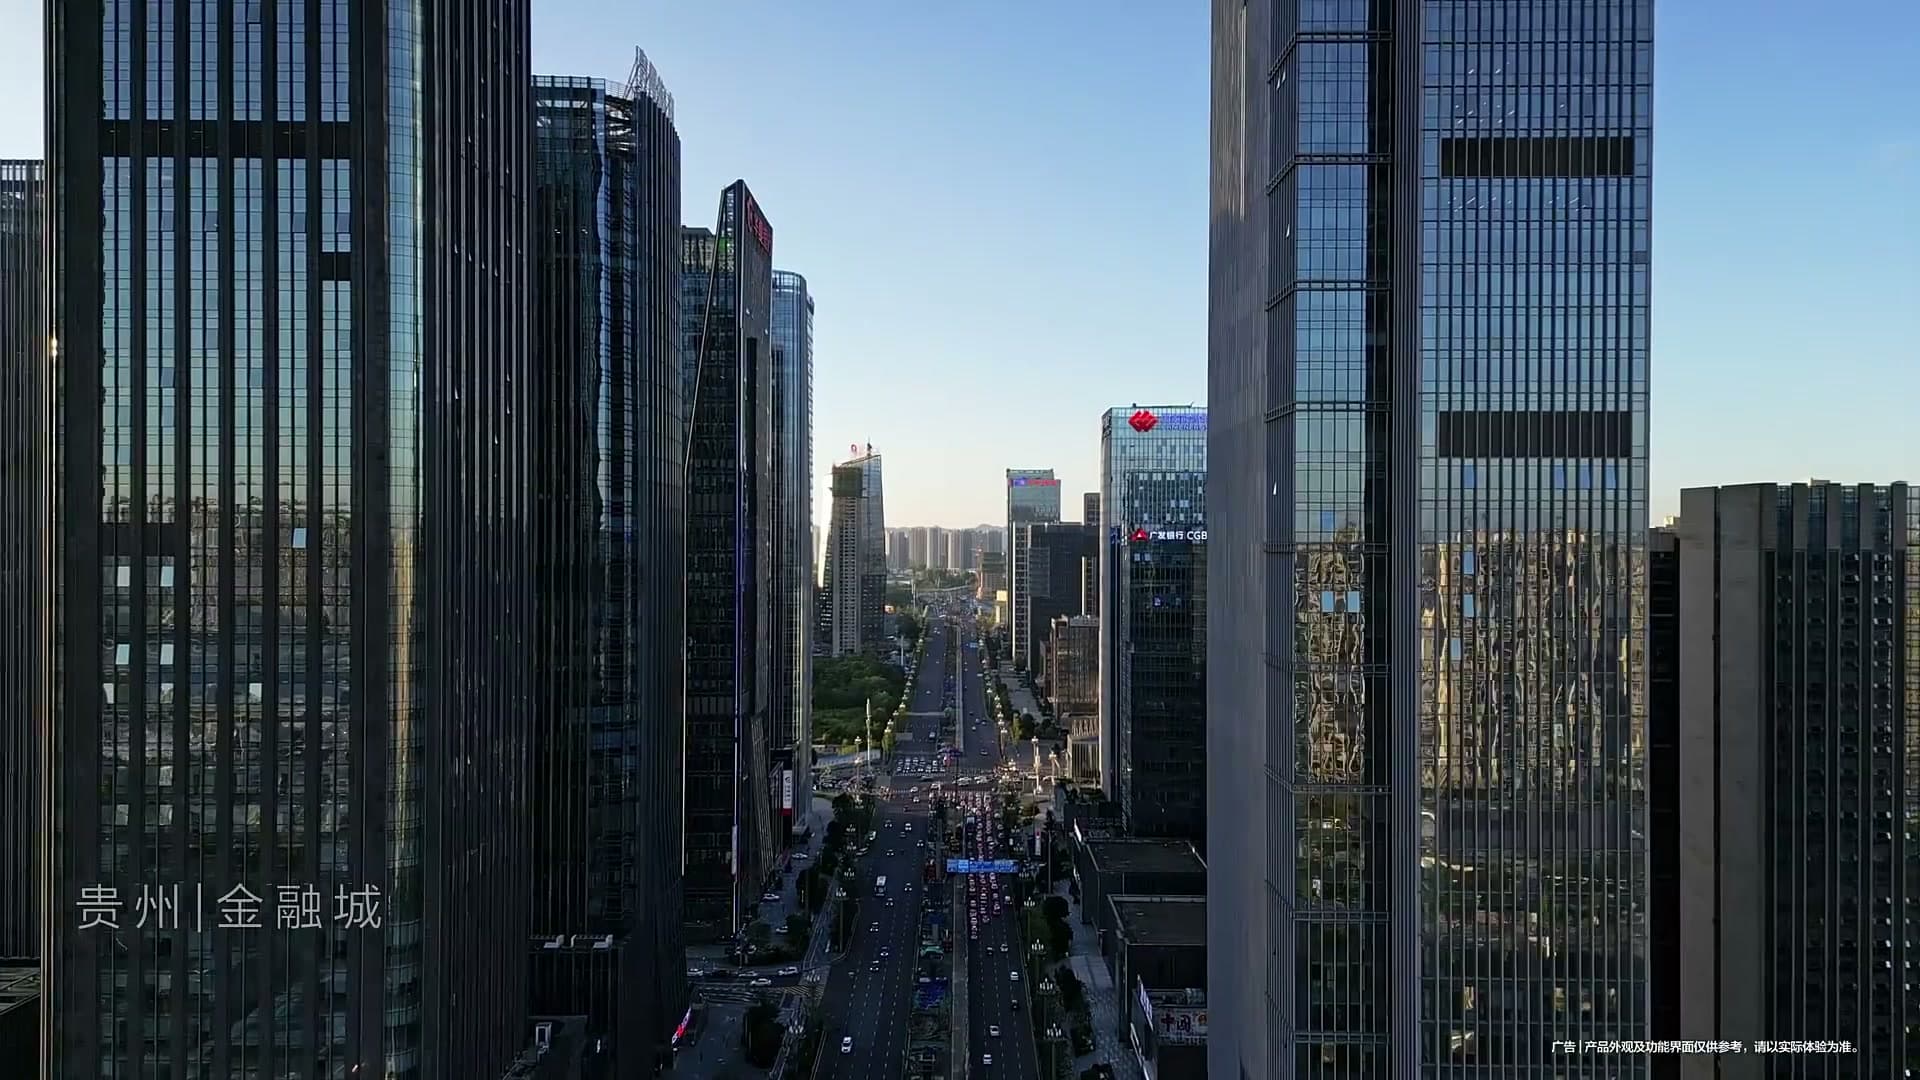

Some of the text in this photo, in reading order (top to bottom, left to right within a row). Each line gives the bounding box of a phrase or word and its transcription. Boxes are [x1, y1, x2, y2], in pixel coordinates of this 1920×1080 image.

[1149, 530, 1208, 540] 广发银行 CGB
